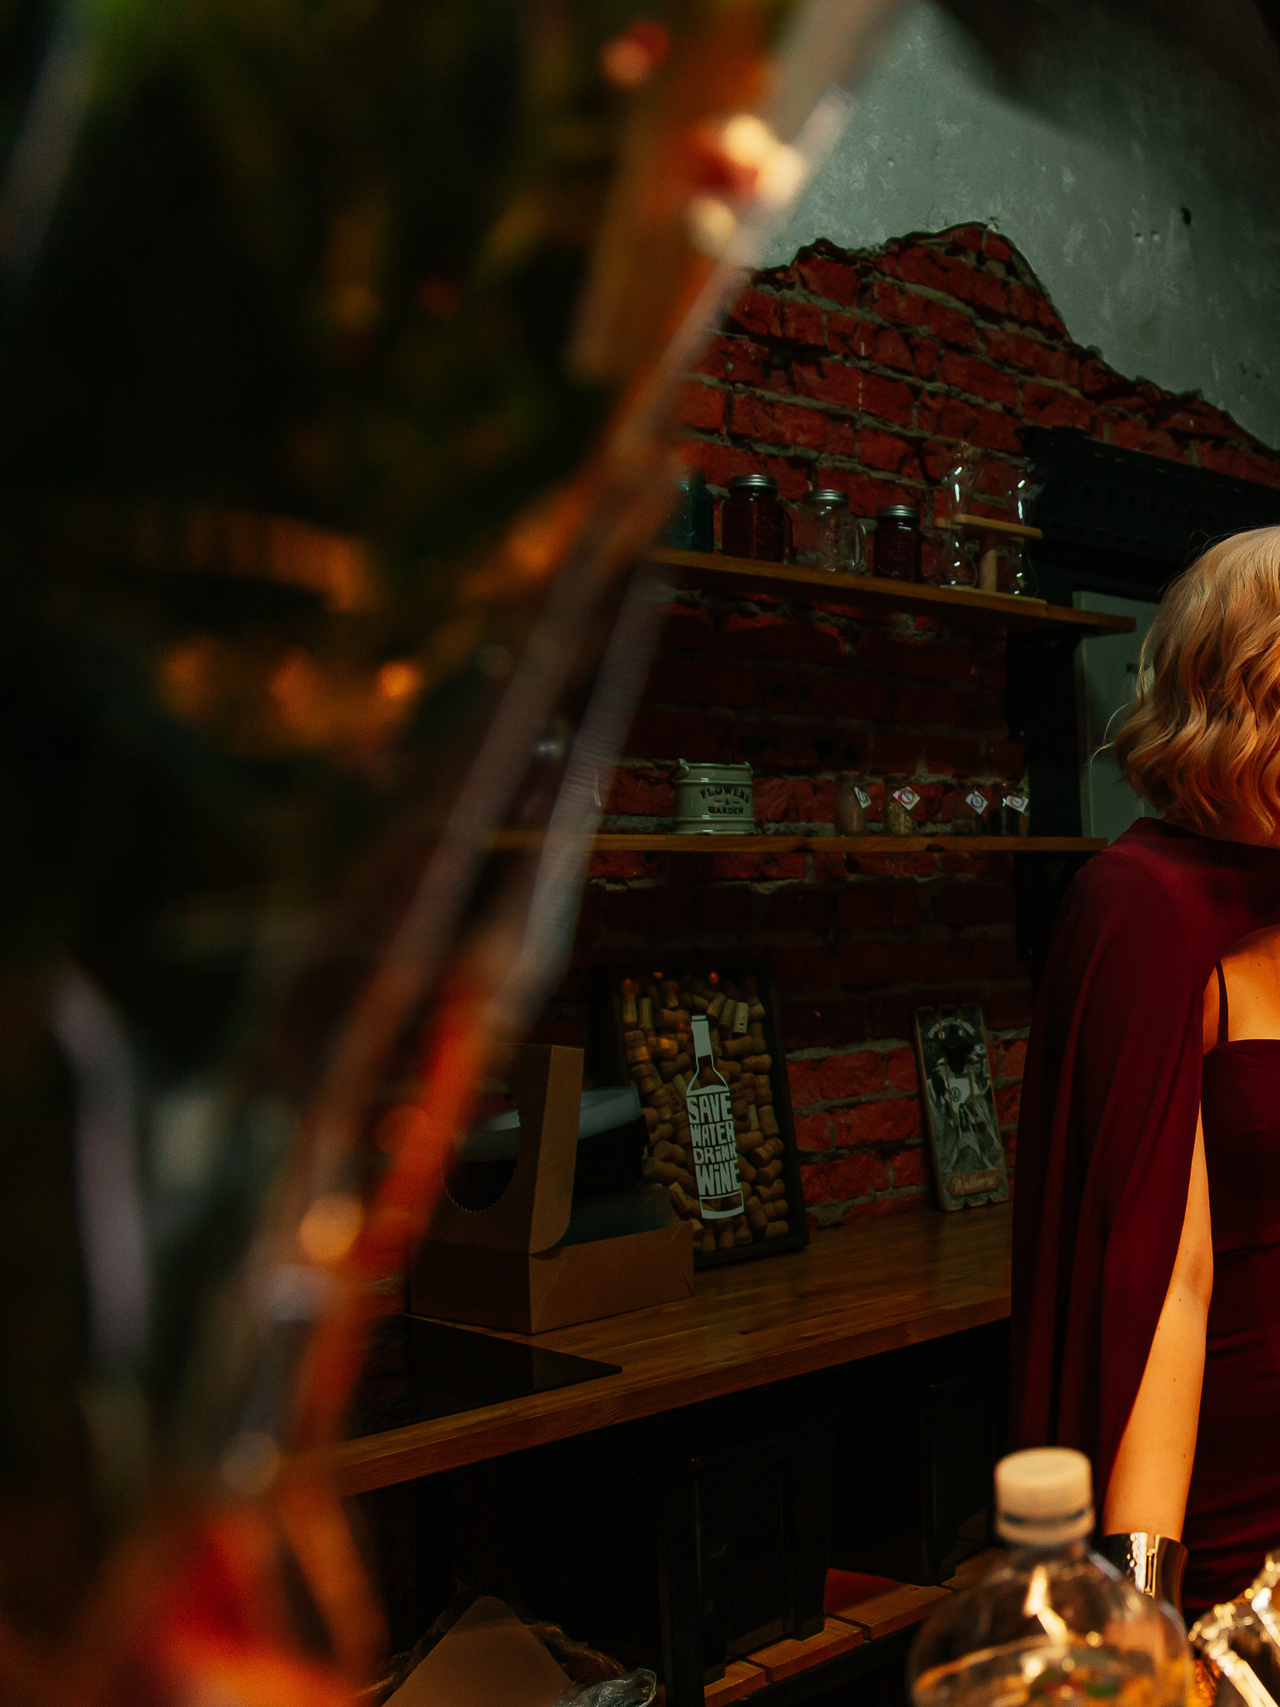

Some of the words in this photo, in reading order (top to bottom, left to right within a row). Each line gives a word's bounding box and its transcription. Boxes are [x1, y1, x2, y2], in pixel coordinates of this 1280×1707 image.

[700, 786, 750, 804] FLOWERS
[707, 806, 744, 815] GARDEN
[686, 1092, 733, 1123] SAVE
[690, 1120, 737, 1147] WATER
